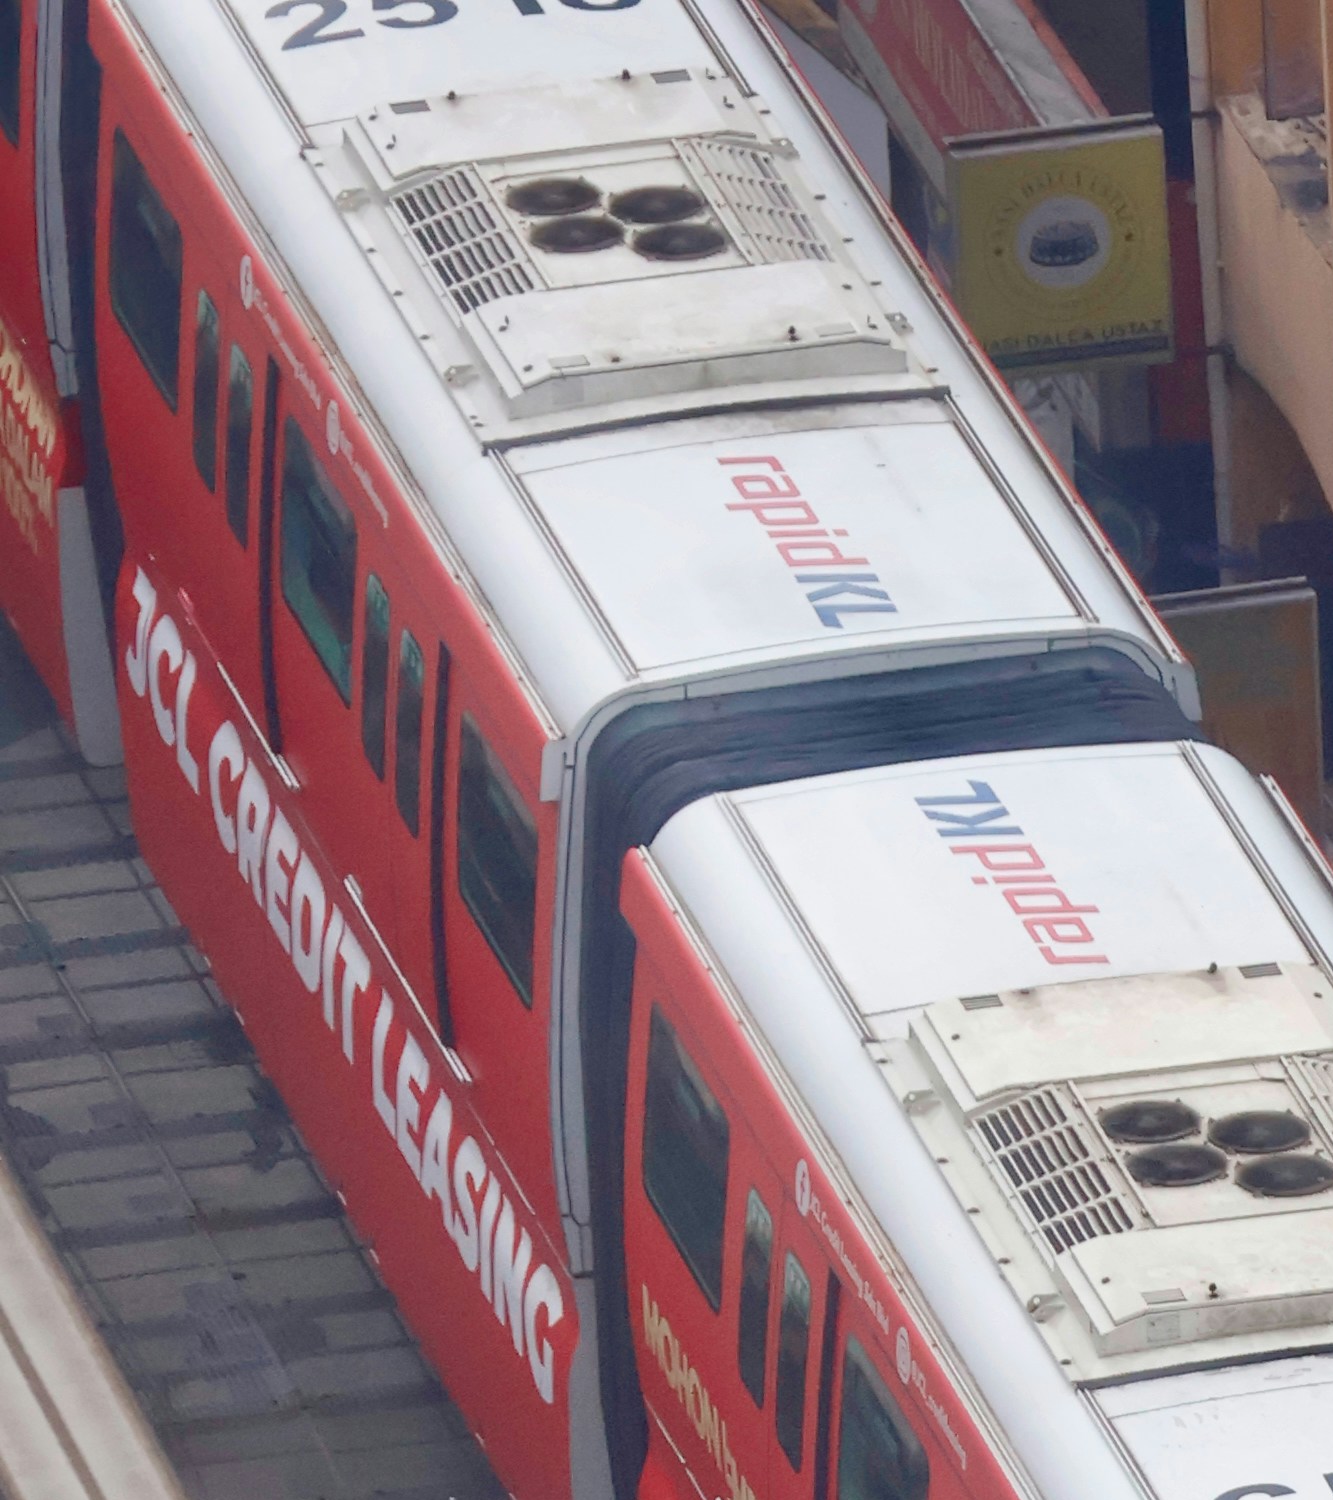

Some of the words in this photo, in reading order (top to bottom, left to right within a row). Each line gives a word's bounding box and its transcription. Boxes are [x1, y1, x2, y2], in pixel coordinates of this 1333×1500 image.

[717, 455, 898, 629] rapidKL
[914, 779, 1110, 965] rapidKL
[126, 565, 199, 797] JCL
[209, 719, 371, 1066] CREDIT
[371, 988, 565, 1405] LEASING
[642, 1283, 723, 1472] MOHON
